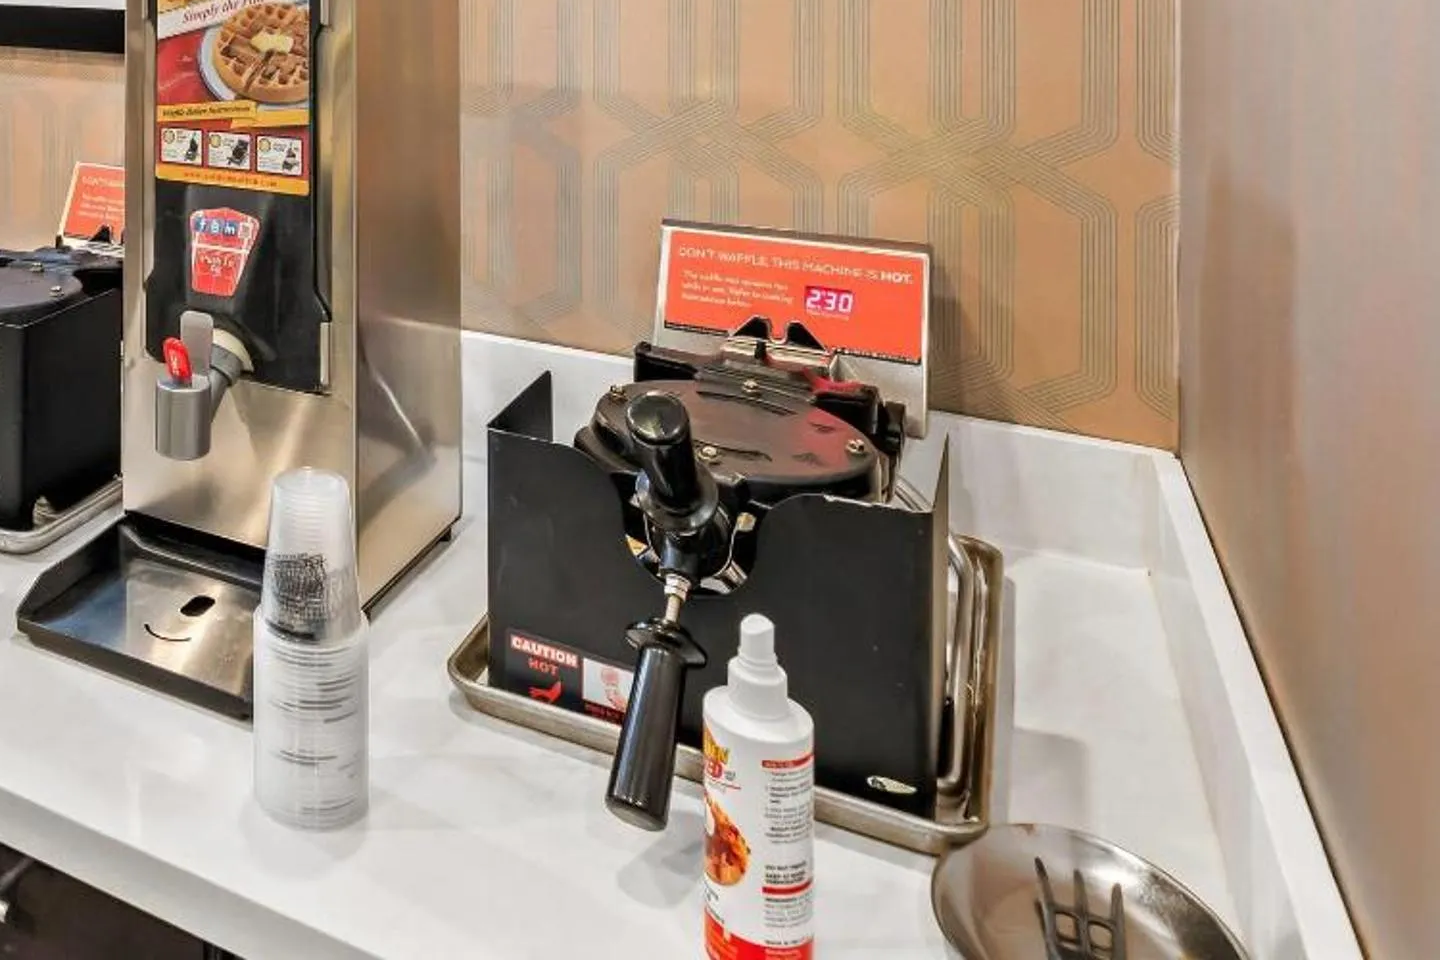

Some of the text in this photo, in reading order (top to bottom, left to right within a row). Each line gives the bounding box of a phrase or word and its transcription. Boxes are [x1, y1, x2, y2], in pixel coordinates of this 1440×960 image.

[182, 2, 220, 23] Simply
[679, 246, 713, 258] DON'T
[771, 256, 800, 270] THIS
[802, 261, 862, 277] MACHINE
[511, 634, 579, 669] CAUTION
[527, 658, 558, 676] HOT
